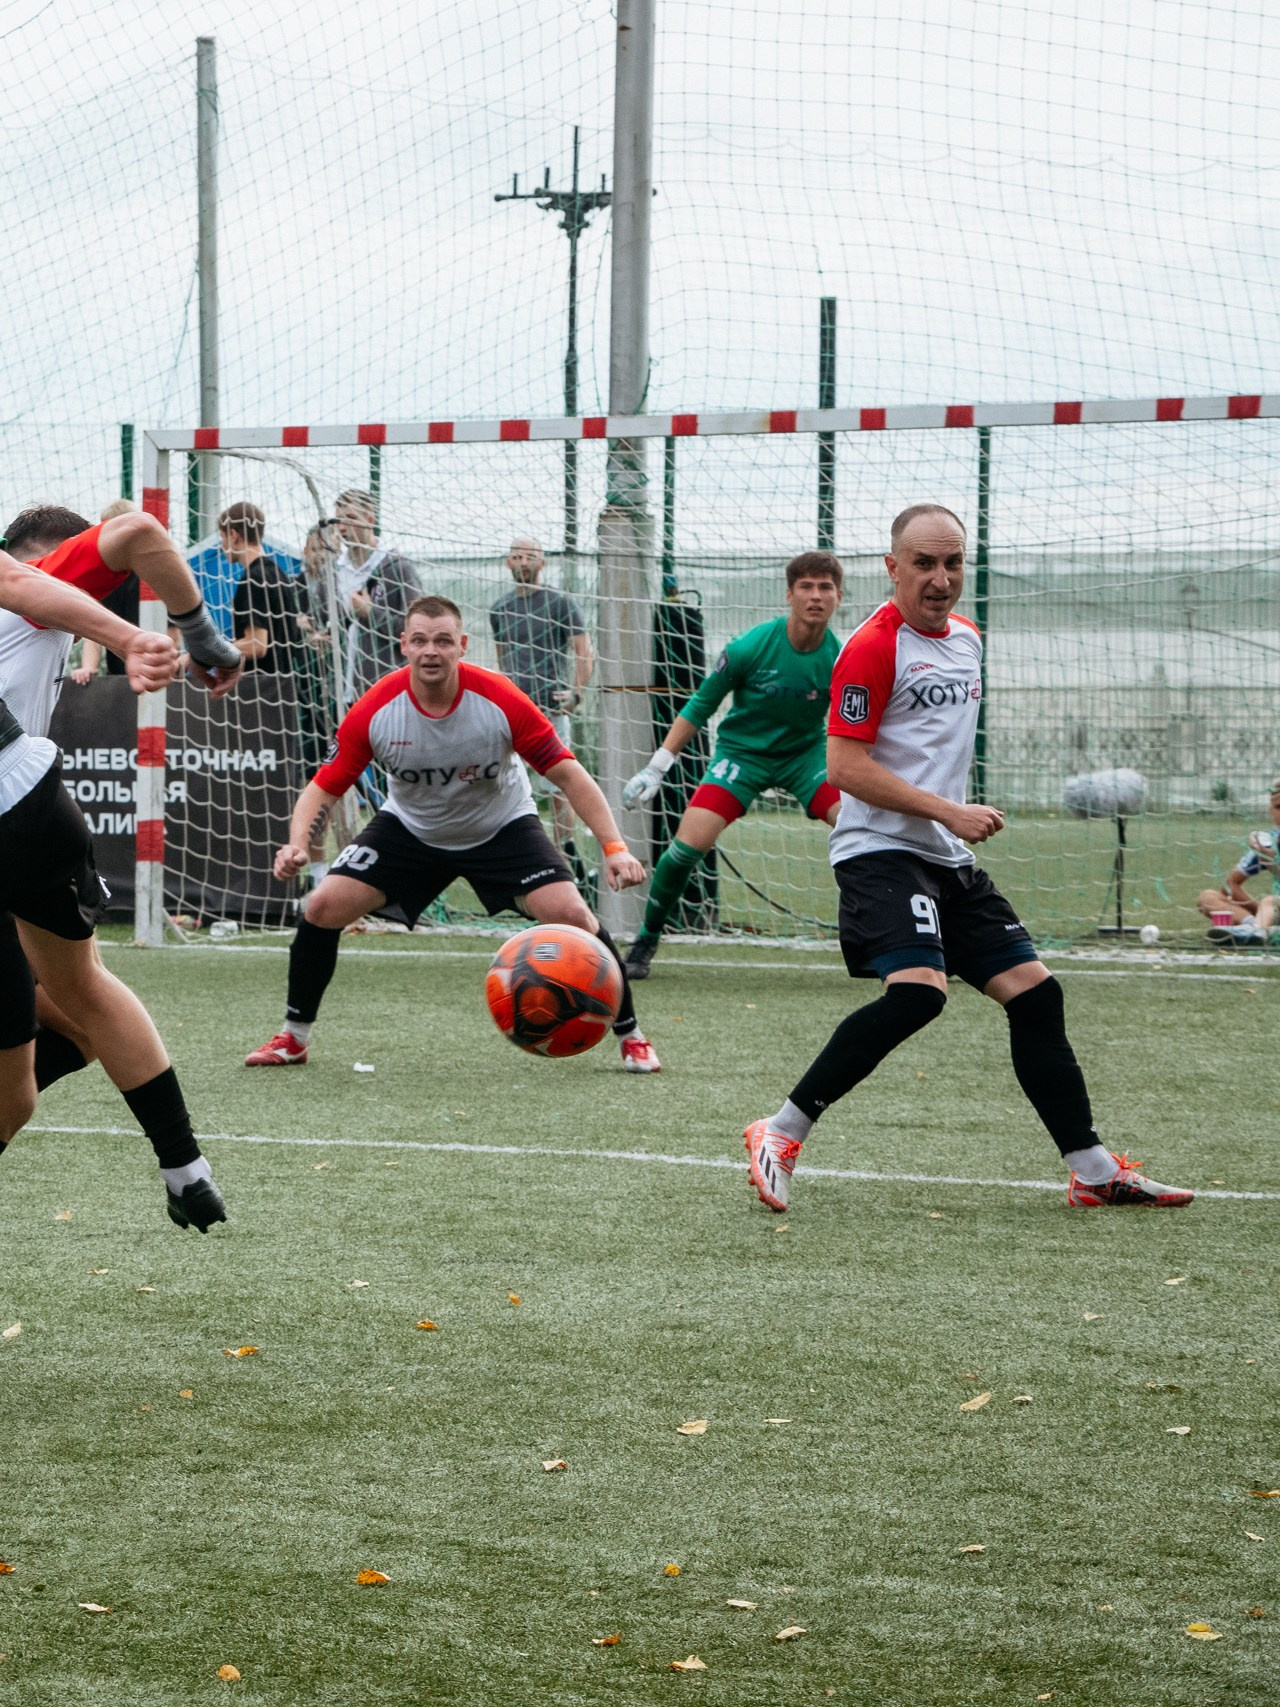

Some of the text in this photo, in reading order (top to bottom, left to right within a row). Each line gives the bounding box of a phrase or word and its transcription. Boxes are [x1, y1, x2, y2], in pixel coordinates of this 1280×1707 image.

[711, 758, 741, 785] 41
[331, 843, 380, 872] 80
[521, 867, 556, 885] MAVEX
